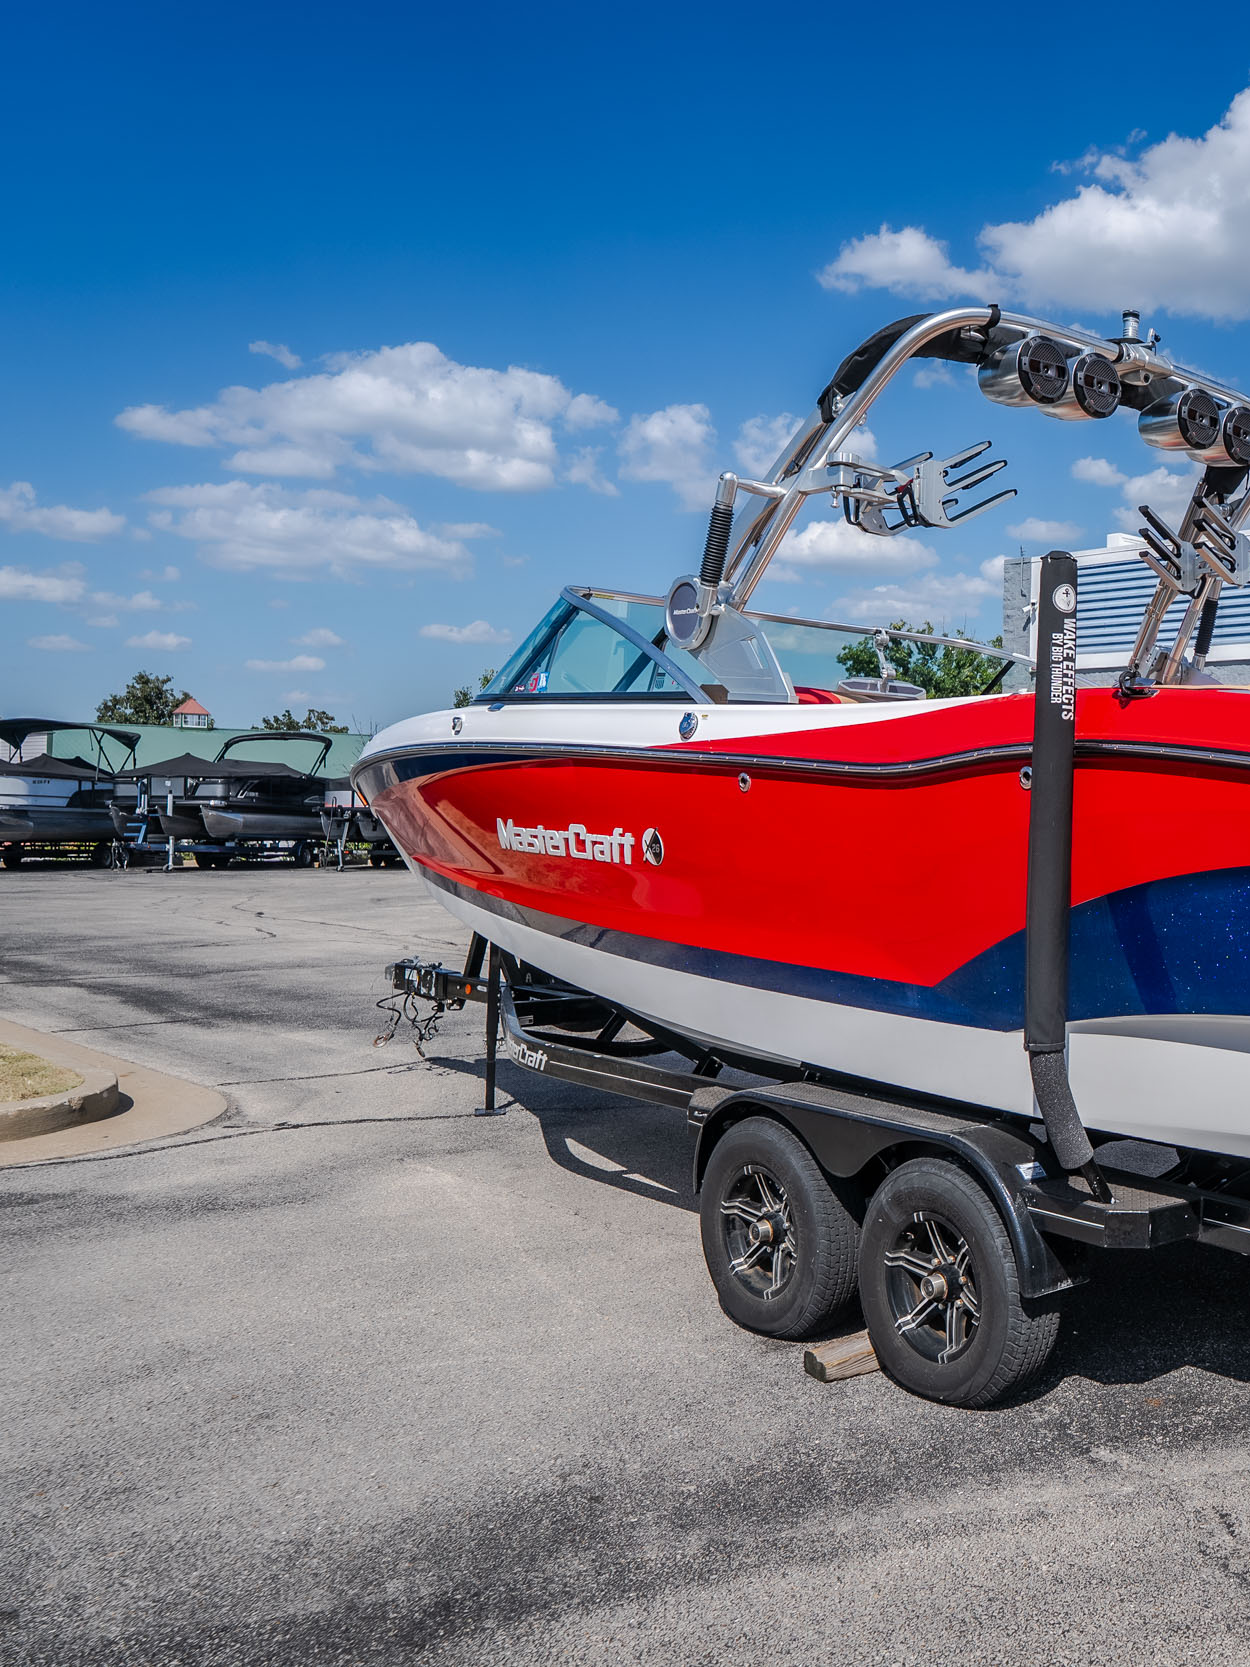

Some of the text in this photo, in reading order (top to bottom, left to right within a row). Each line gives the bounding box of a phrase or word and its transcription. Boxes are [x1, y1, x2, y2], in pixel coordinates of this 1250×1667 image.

[1050, 632, 1064, 704] BY BIG THUNDER
[1061, 618, 1076, 721] WAKE EFFECTS
[496, 817, 636, 865] MasterCraft
